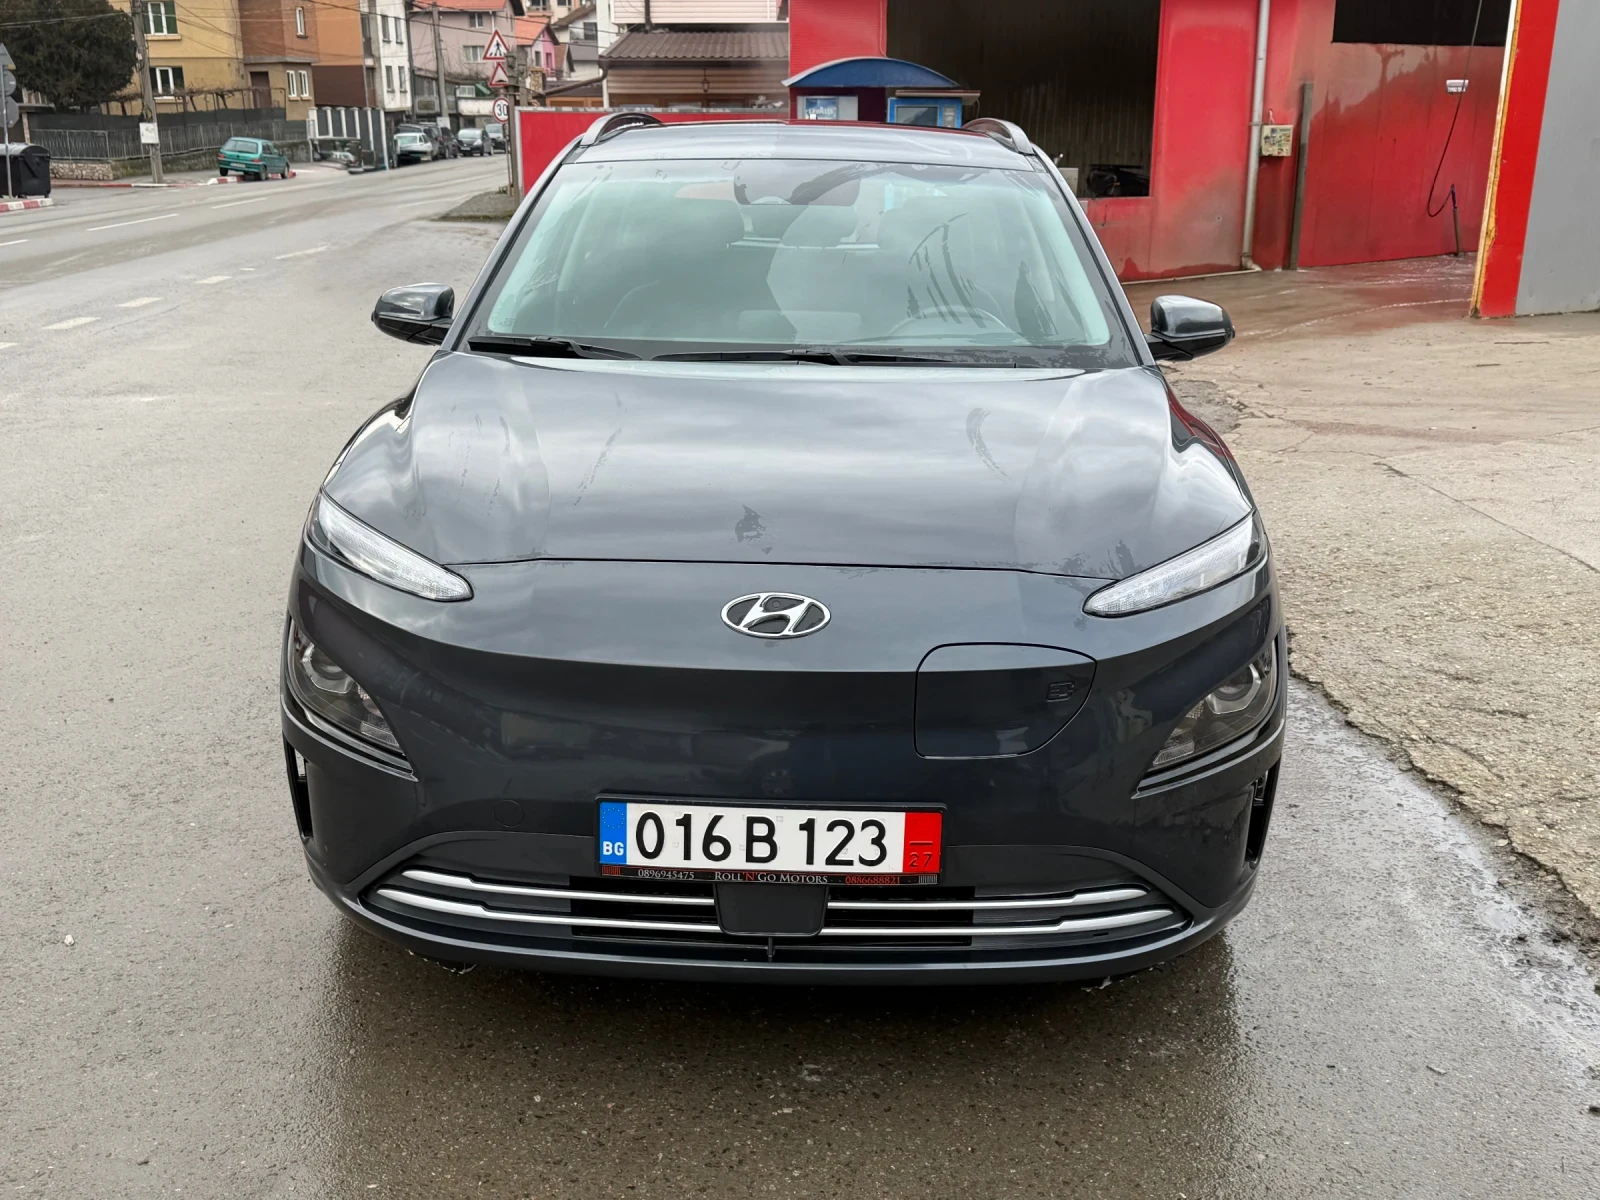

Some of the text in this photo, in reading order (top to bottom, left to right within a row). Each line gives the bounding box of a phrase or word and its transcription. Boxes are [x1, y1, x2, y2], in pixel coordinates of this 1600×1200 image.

[496, 103, 509, 117] 30
[635, 811, 888, 867] 016 B 123
[602, 840, 625, 856] BG
[908, 851, 933, 868] 27
[637, 868, 695, 880] 0896945475
[779, 874, 828, 884] MOTORS
[845, 875, 900, 884] 0886688821
